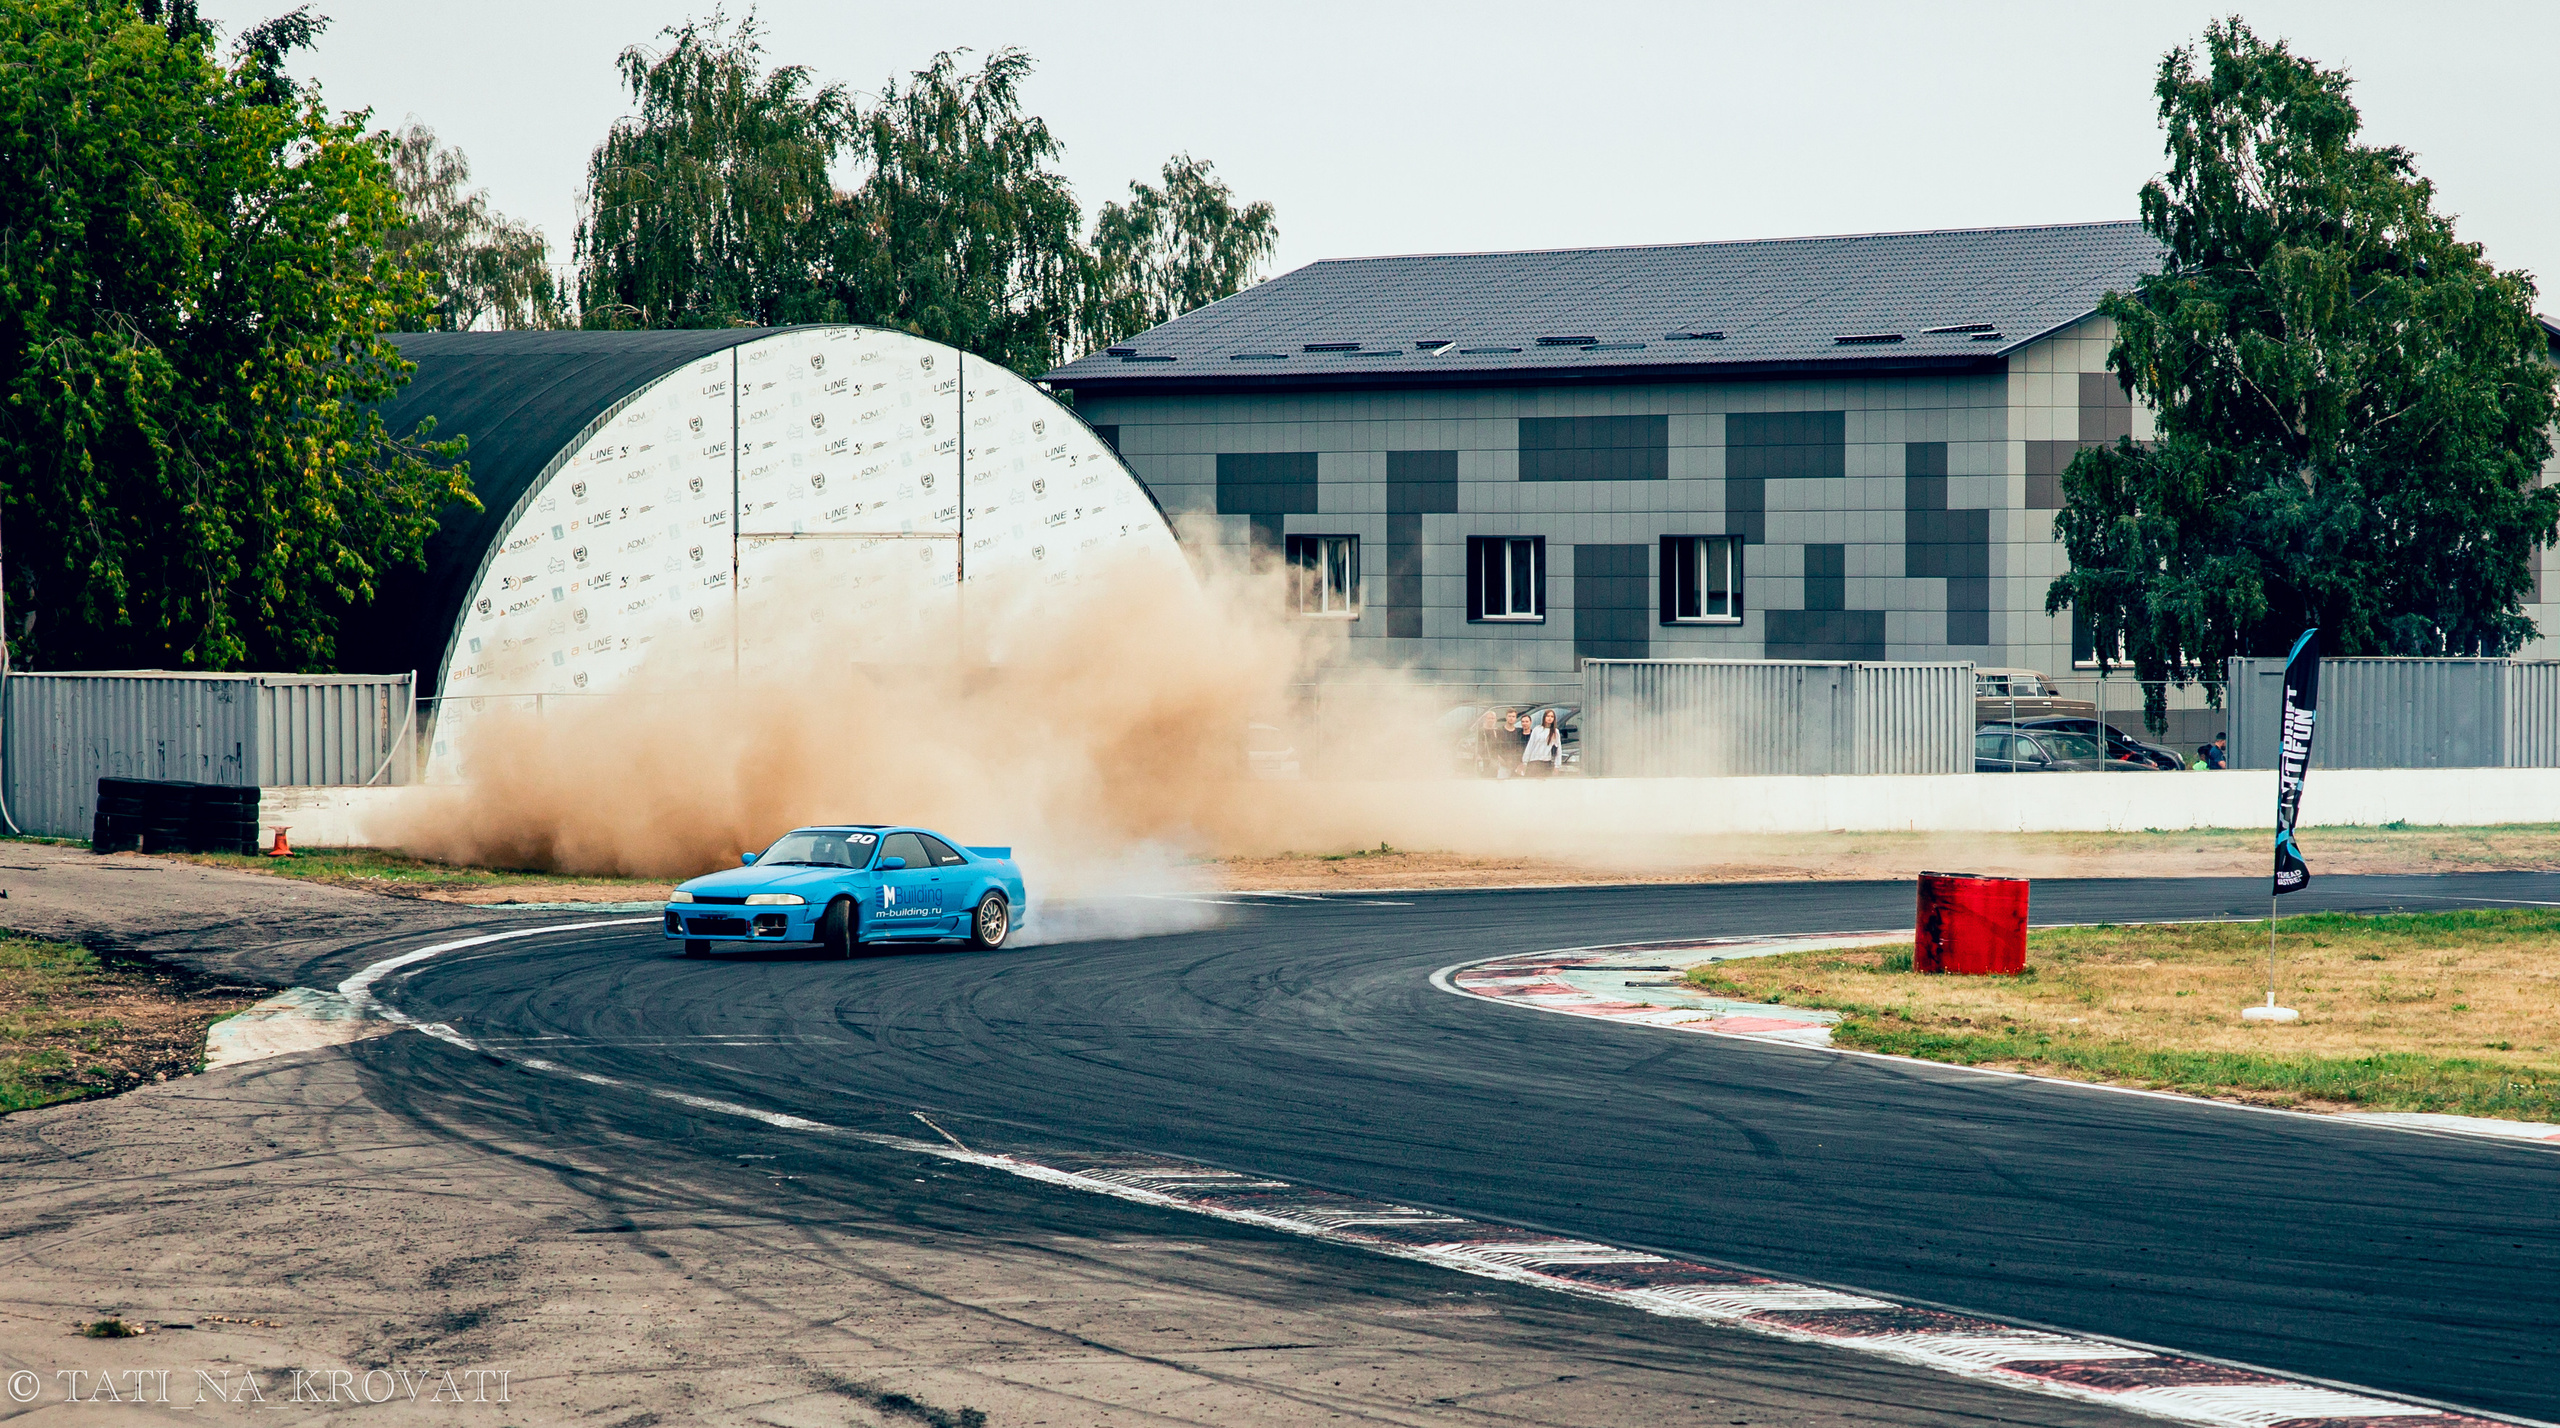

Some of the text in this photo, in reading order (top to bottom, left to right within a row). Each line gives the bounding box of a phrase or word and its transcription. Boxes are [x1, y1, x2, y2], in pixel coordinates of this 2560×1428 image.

[2292, 708, 2313, 753] FUN
[846, 834, 876, 844] 20
[876, 908, 942, 917] m-building.ru
